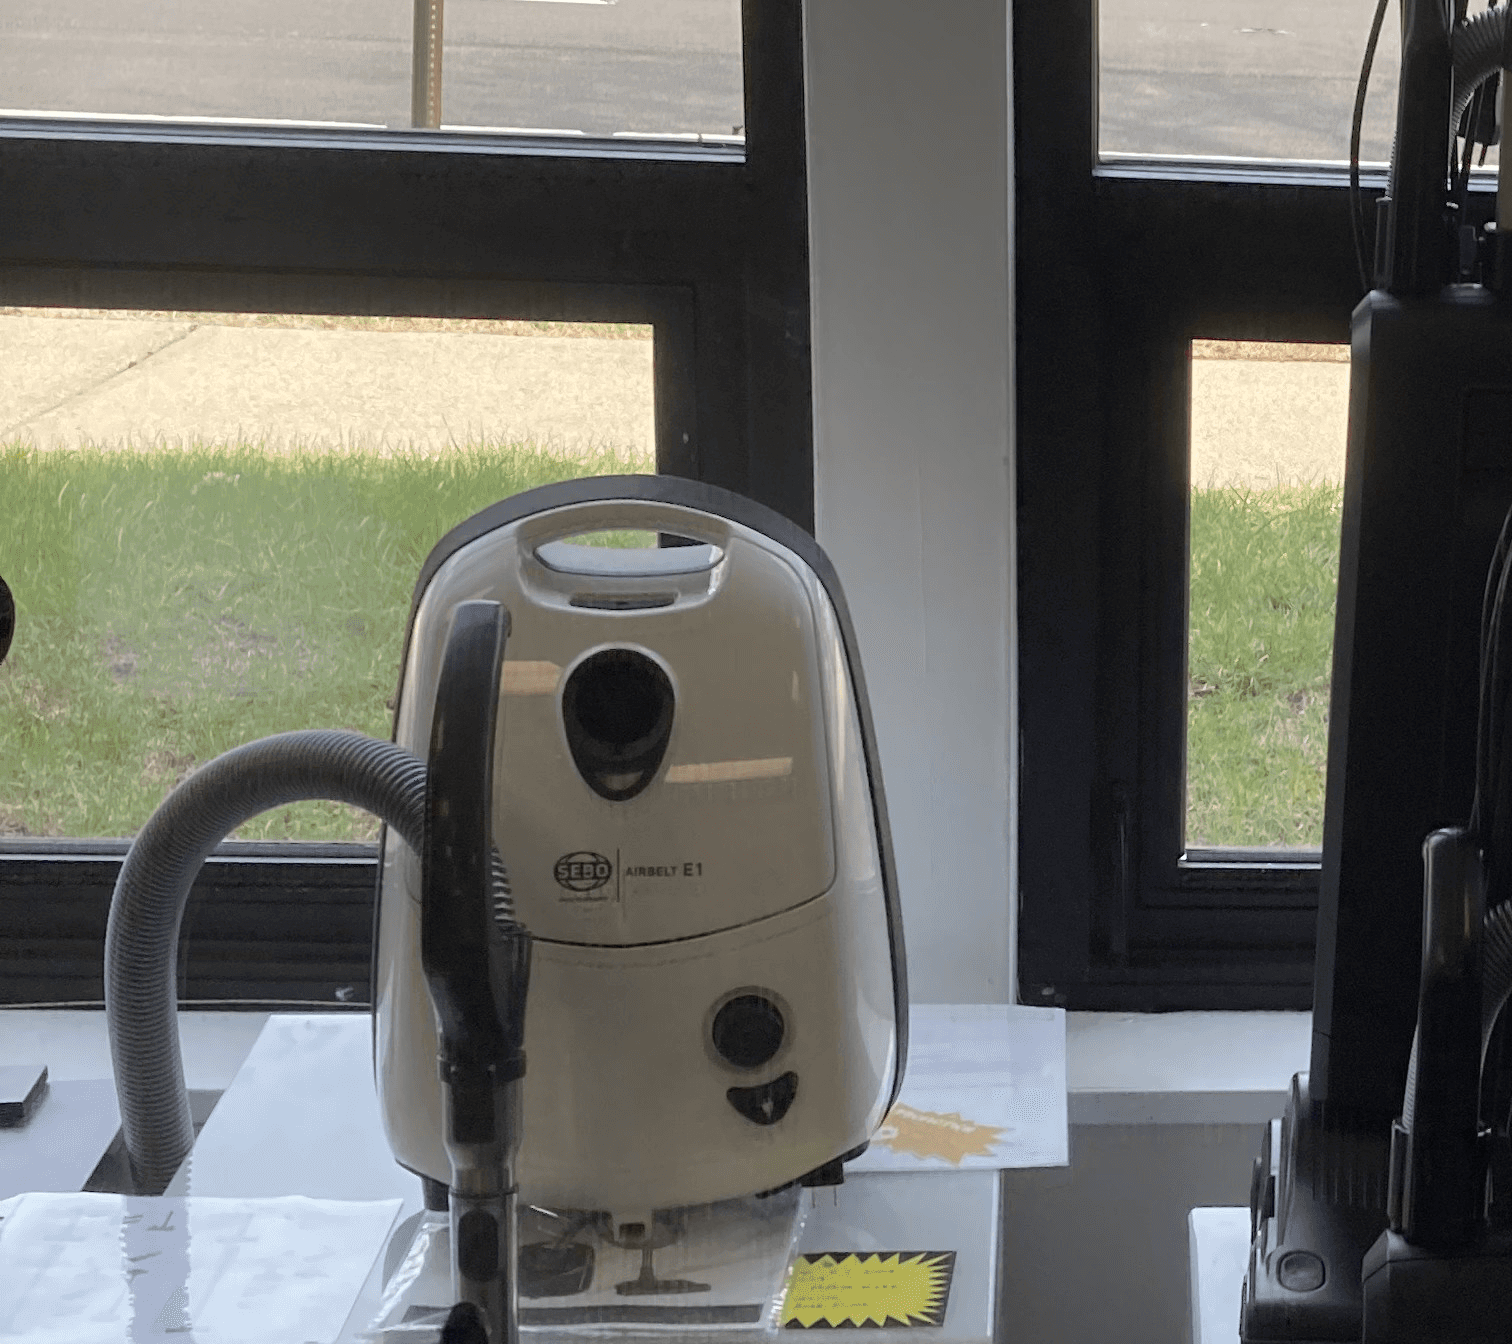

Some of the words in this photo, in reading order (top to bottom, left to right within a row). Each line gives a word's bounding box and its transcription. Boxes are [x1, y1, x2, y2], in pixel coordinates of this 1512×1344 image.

[556, 863, 610, 879] SEBO
[625, 865, 679, 878] AIRBELT
[683, 862, 704, 877] E1
